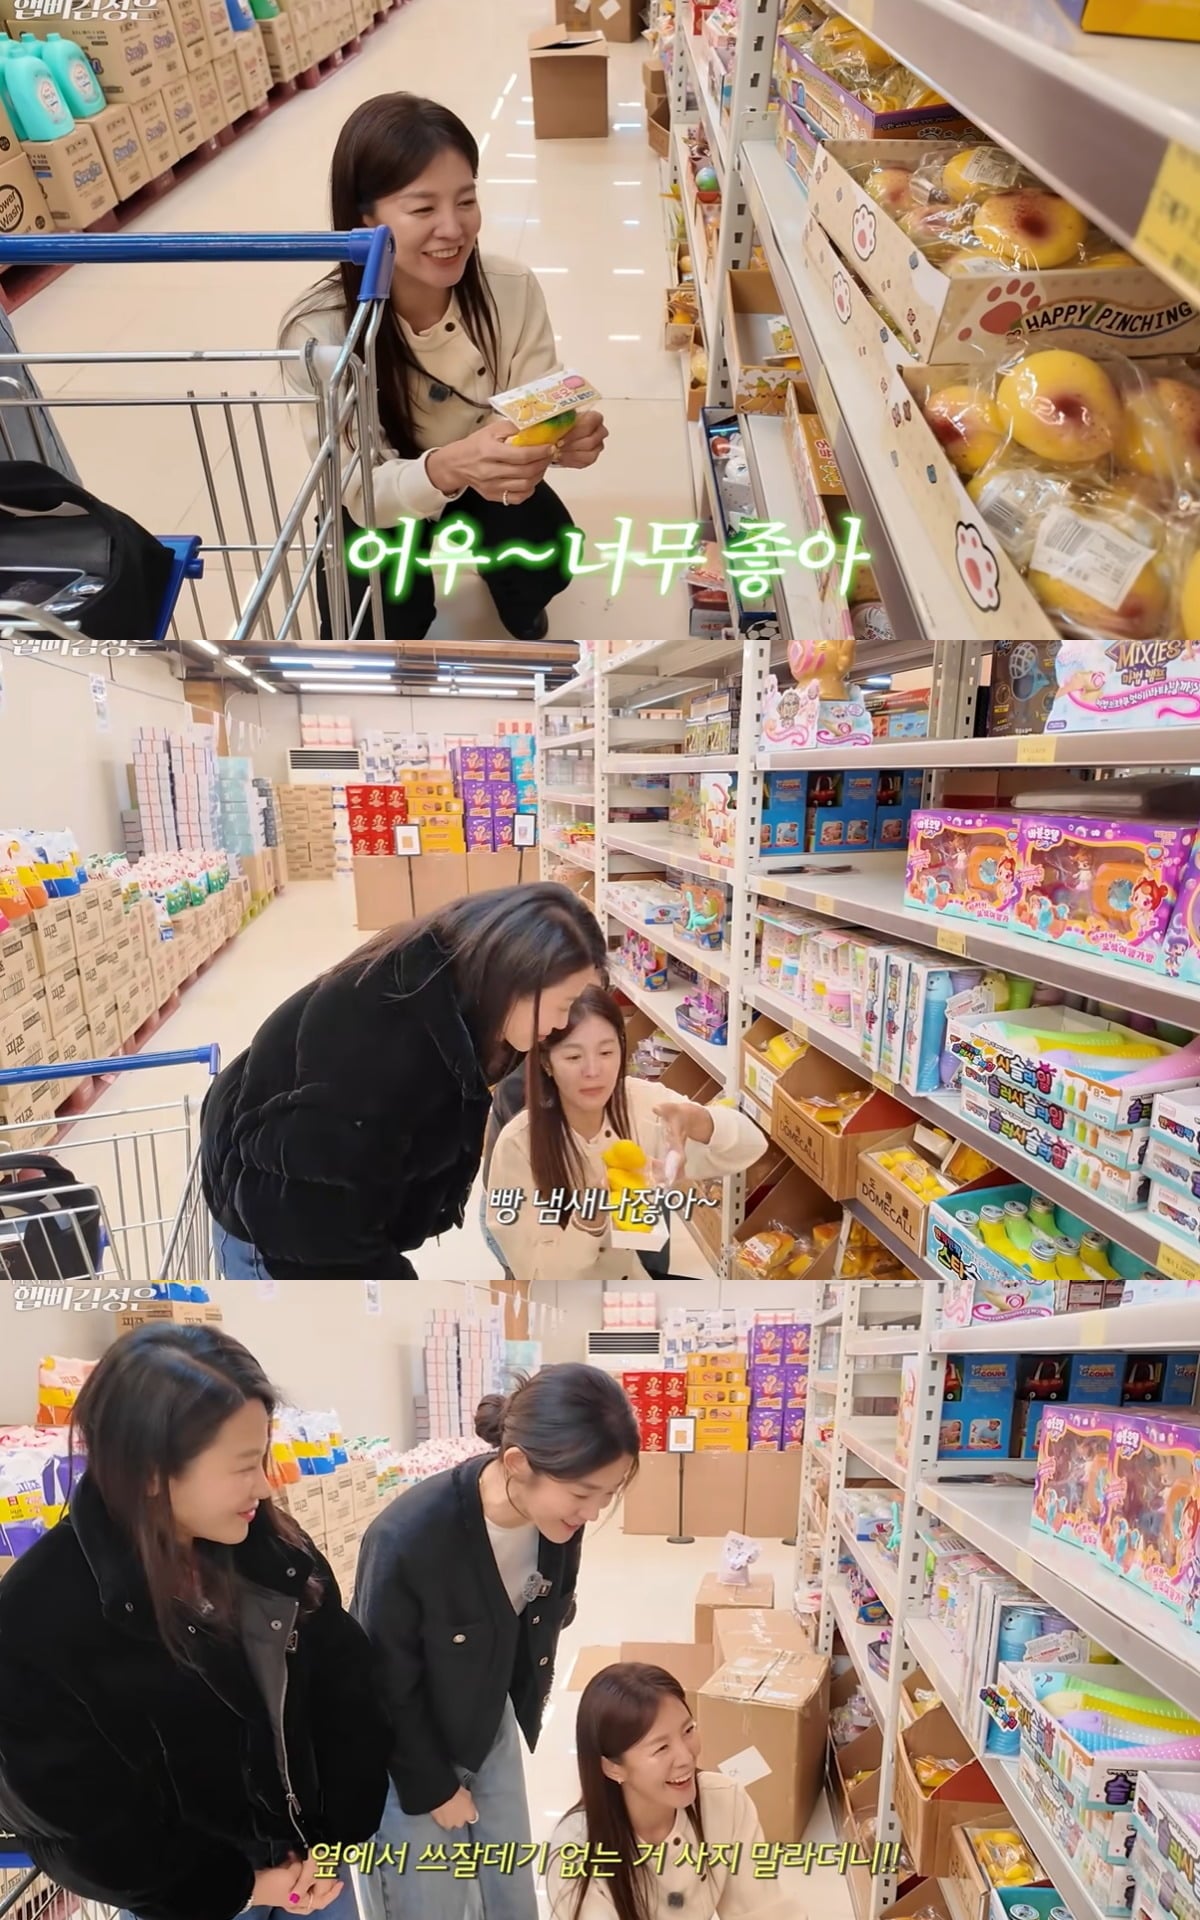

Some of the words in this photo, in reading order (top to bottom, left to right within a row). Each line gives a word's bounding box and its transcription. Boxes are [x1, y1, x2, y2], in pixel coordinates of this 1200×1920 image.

[0, 203, 23, 229] Wash
[1025, 303, 1092, 331] HAPPY
[1094, 301, 1193, 333] PINCHING
[861, 1184, 916, 1241] DOMECALL
